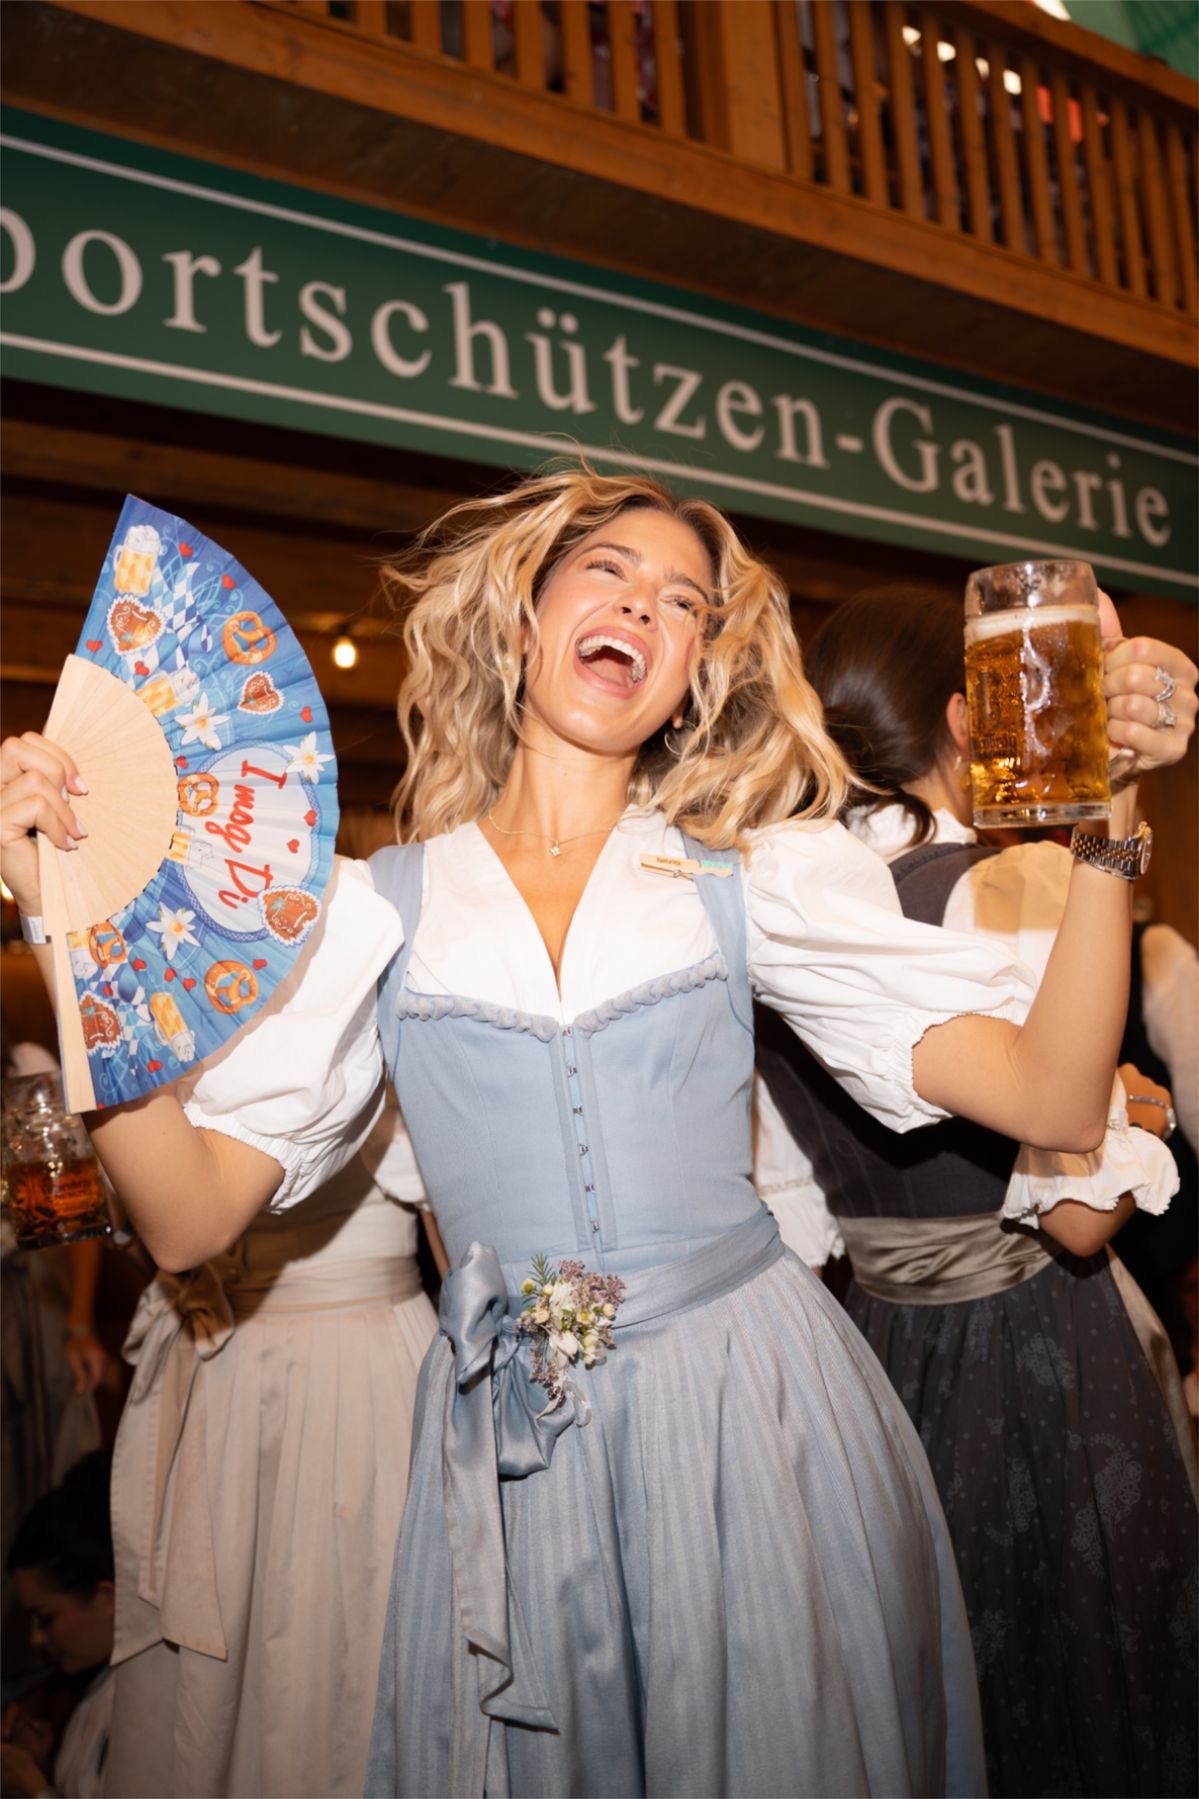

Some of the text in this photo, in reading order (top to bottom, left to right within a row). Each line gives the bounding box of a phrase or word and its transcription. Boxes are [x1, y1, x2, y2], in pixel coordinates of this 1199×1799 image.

[204, 759, 288, 909] I mog Di
